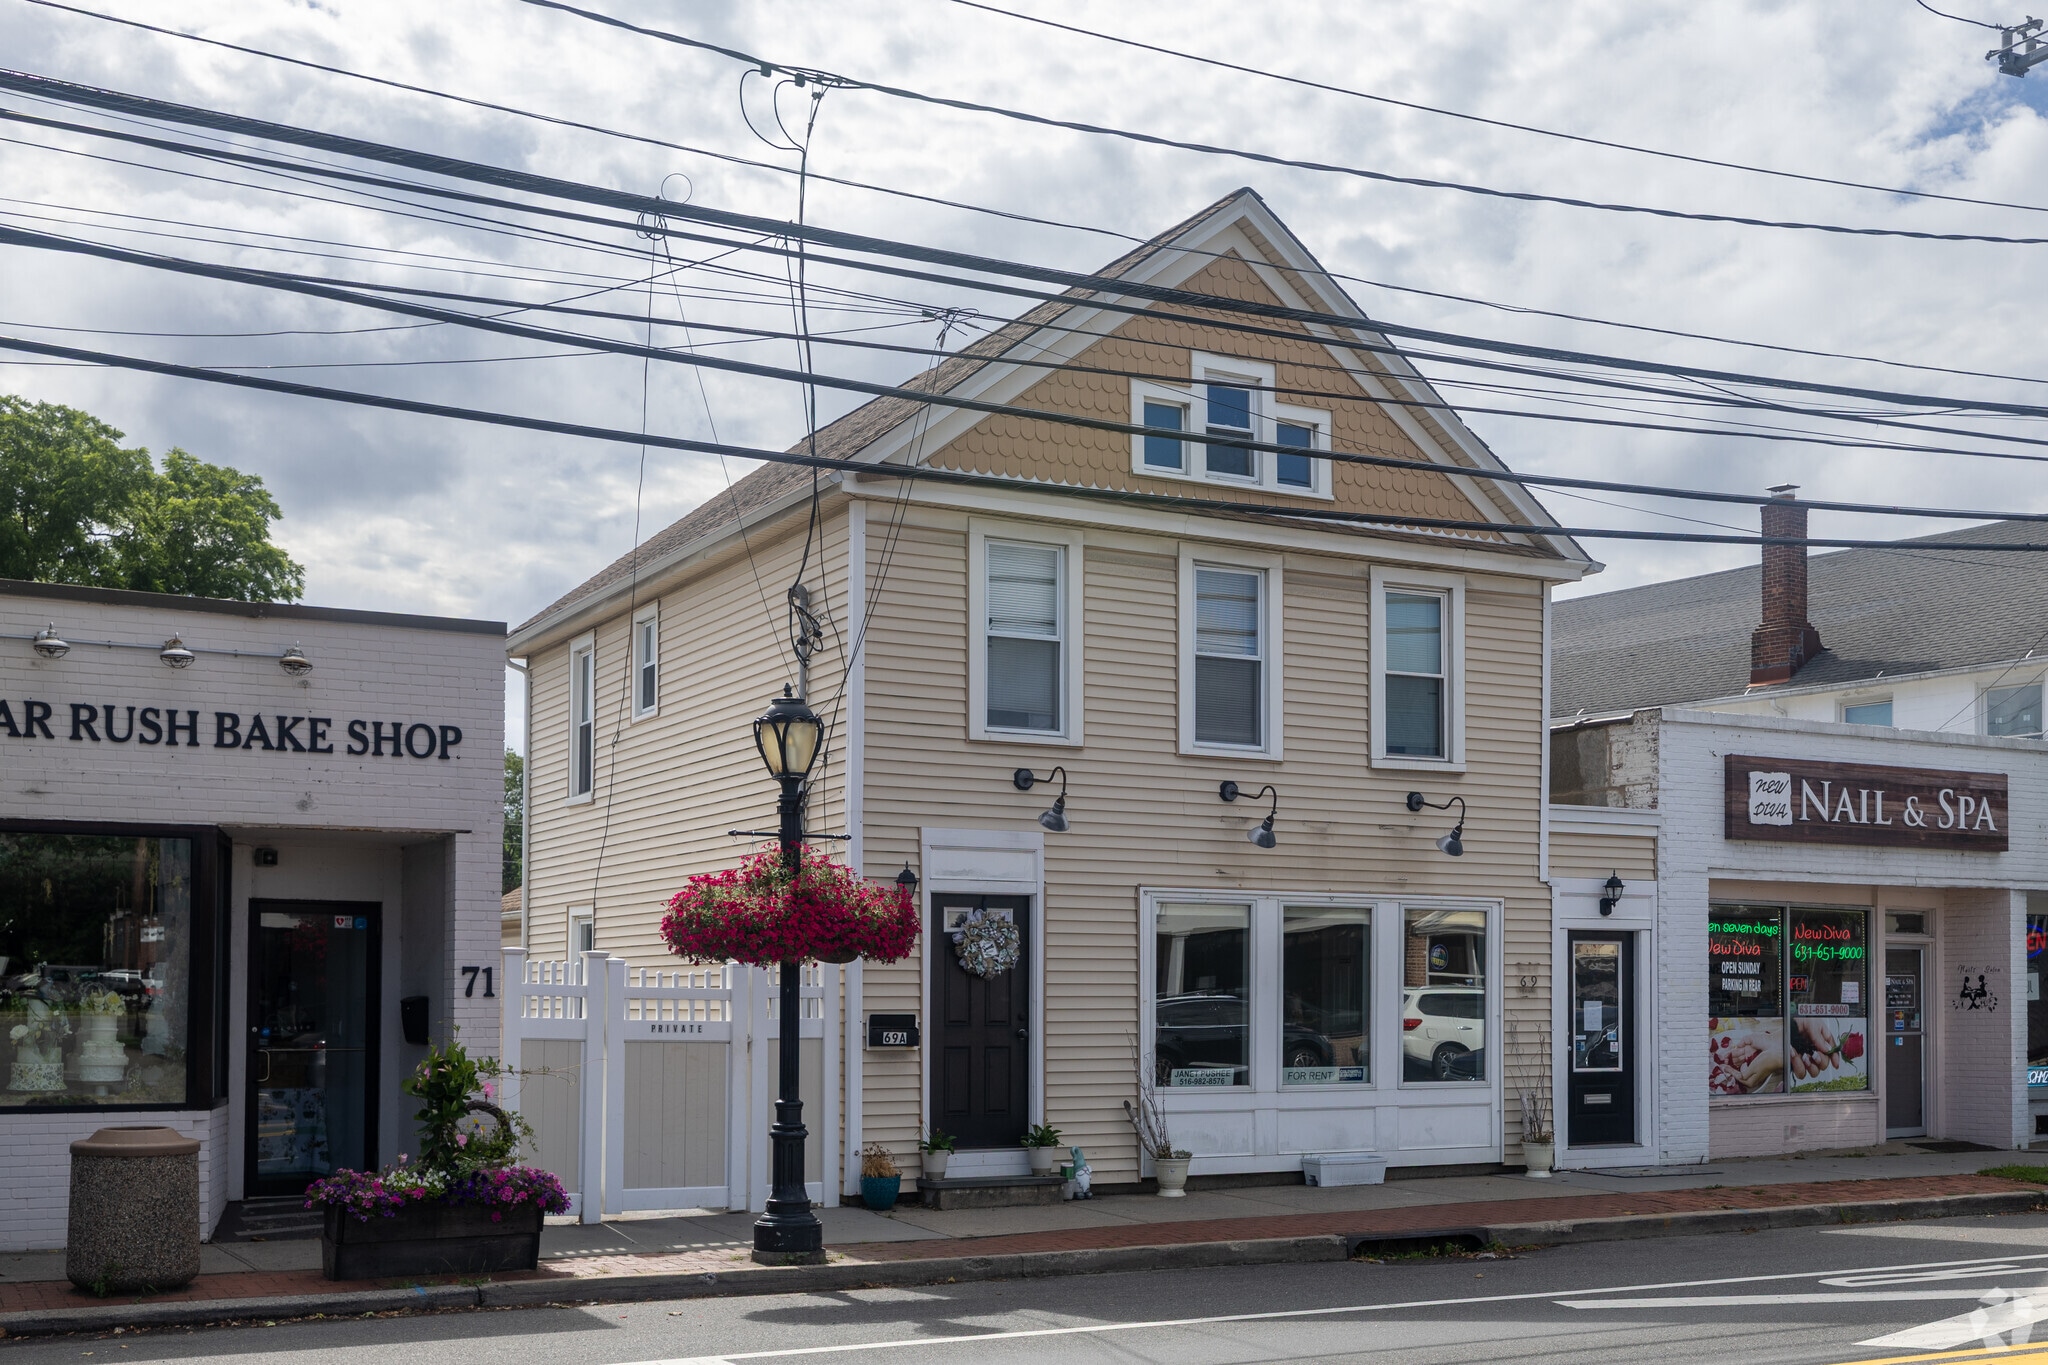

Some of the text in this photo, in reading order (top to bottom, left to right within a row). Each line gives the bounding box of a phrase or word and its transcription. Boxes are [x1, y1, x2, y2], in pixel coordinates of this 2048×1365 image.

[69, 703, 200, 747] RUSH
[214, 712, 334, 754] BAKE
[347, 719, 463, 760] SHOP
[1755, 779, 1789, 795] NEW
[1753, 802, 1789, 819] DIVA
[1798, 778, 1998, 832] NAIL & SPA
[1722, 923, 1753, 934] seven
[1753, 921, 1779, 937] days
[1794, 923, 1851, 940] New Diva
[1732, 939, 1761, 955] Diva
[1794, 943, 1863, 962] 631-651-9000
[1721, 961, 1760, 974] OPEN SUNDAY
[461, 966, 496, 998] 71
[1520, 975, 1538, 989] 69
[1721, 978, 1761, 992] PARKING IN REAR
[1799, 1005, 1849, 1015] 631-651-9000
[651, 1025, 703, 1033] PRIVATE
[884, 1033, 906, 1044] 69A
[1174, 1070, 1231, 1078] JANET PUSHEE
[1287, 1071, 1307, 1080] FOR
[1309, 1071, 1334, 1080] RENT
[1179, 1078, 1226, 1086] 516-982-8576
